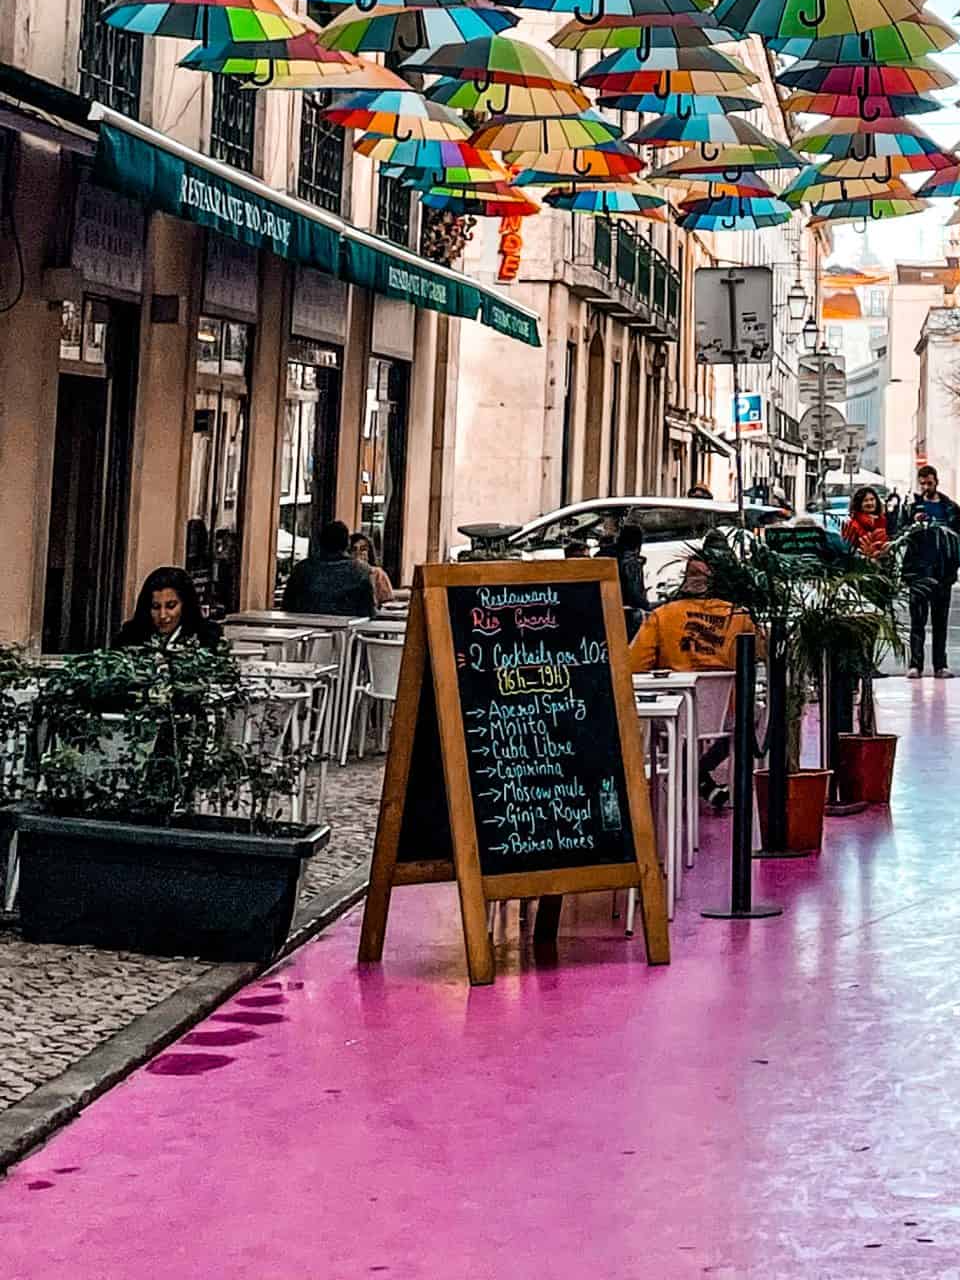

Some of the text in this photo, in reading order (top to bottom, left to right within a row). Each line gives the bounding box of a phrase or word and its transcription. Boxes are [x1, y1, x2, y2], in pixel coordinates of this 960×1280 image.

[476, 586, 560, 607] Restaurante
[471, 607, 557, 629] Rio Grande
[469, 642, 485, 672] 2
[493, 639, 553, 670] Cocktails
[488, 687, 587, 727] Aperol Spritz
[492, 733, 576, 760] Cuba Libre
[497, 757, 565, 785] Caipirinha
[503, 776, 586, 802] Moscow mule
[506, 799, 592, 835] Ginja Royal
